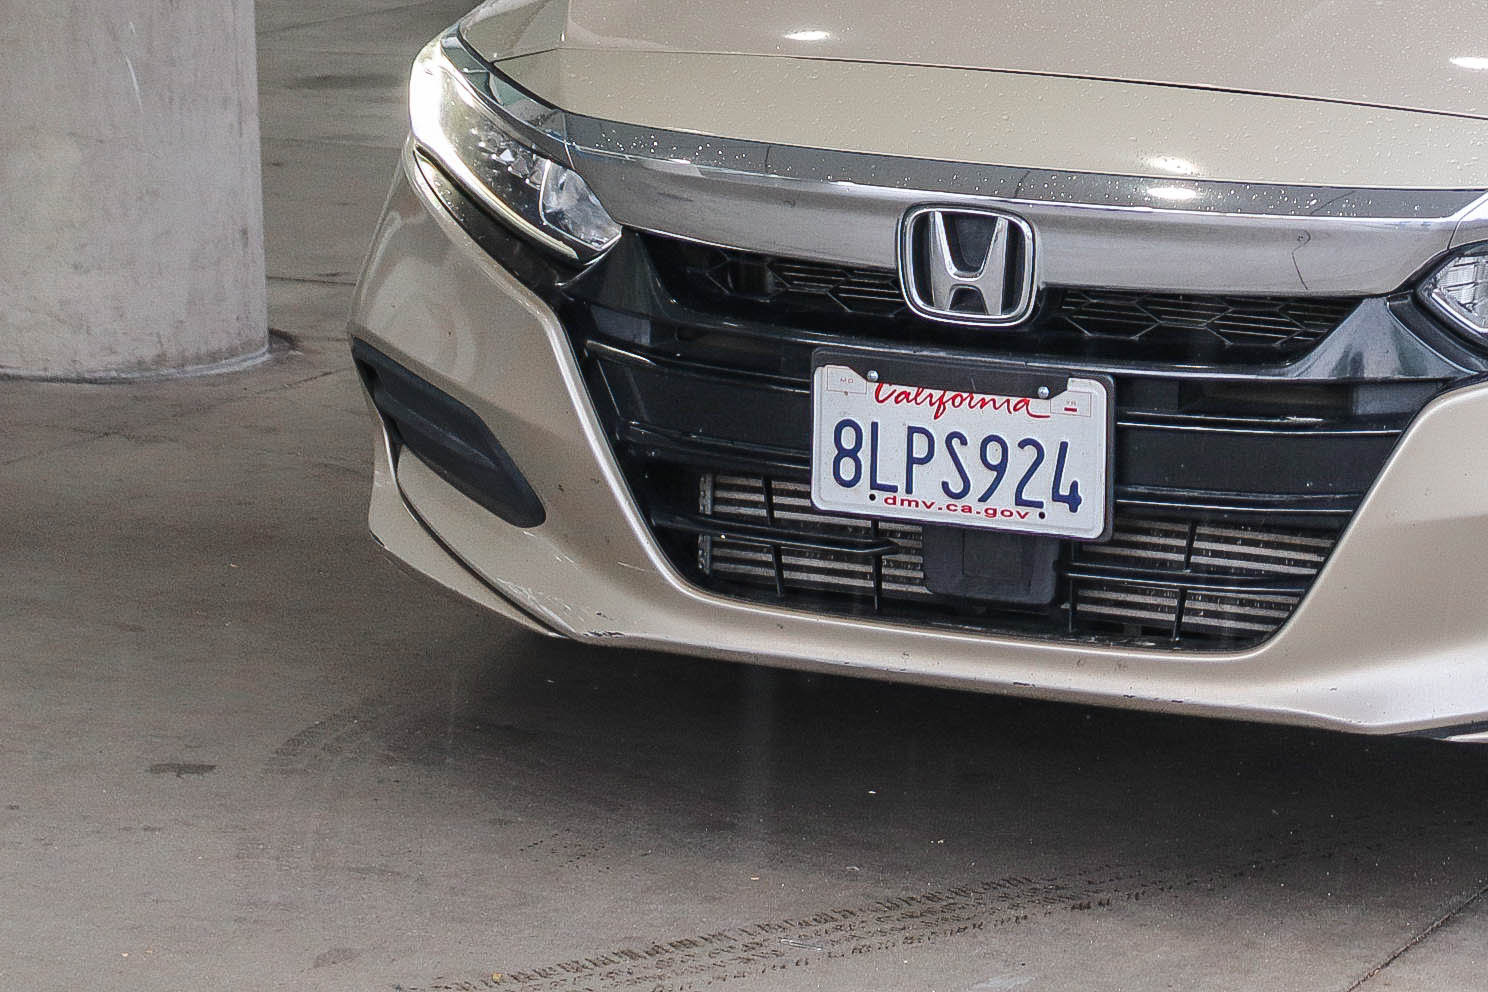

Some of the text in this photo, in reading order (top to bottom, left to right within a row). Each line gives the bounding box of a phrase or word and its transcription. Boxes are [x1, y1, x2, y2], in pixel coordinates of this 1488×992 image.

[875, 382, 1051, 420] California
[832, 418, 1082, 513] 8LPS924
[884, 494, 1030, 520] dmv.ca.gov
